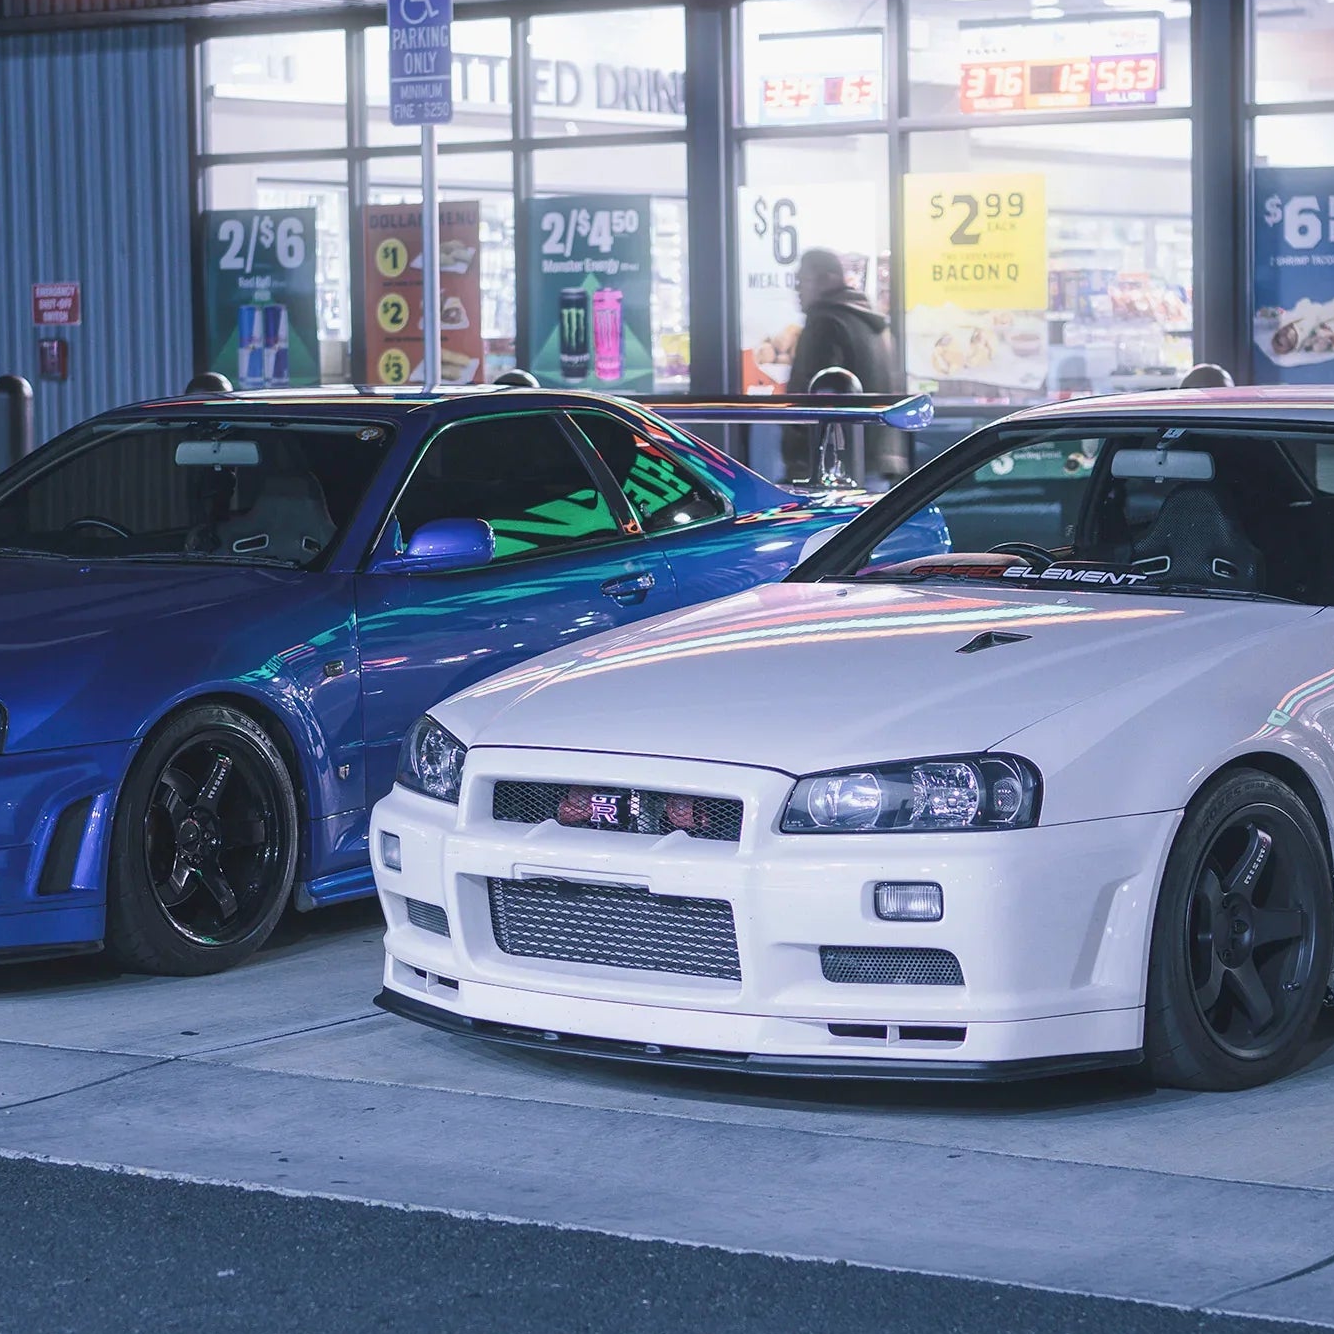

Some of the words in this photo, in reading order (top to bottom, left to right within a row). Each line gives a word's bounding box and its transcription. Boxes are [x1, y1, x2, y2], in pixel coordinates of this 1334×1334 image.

[392, 24, 449, 50] PARKING
[403, 50, 438, 75] ONLY
[596, 61, 686, 114] DRIN
[965, 65, 1023, 99] 376
[1058, 62, 1090, 93] 12
[1095, 58, 1157, 92] 563
[400, 82, 443, 100] MINIMUM
[393, 103, 416, 118] FINE
[424, 101, 450, 118] $250
[754, 195, 798, 265] $6
[1263, 193, 1323, 250] $6
[218, 215, 306, 274] 2/$6
[382, 246, 399, 270] $1
[542, 259, 584, 274] Monster
[584, 257, 620, 275] Energy
[748, 272, 780, 289] MEAL
[932, 264, 1000, 282] BACON
[1006, 263, 1019, 282] Q
[382, 302, 404, 325] $2
[384, 362, 404, 383] $3
